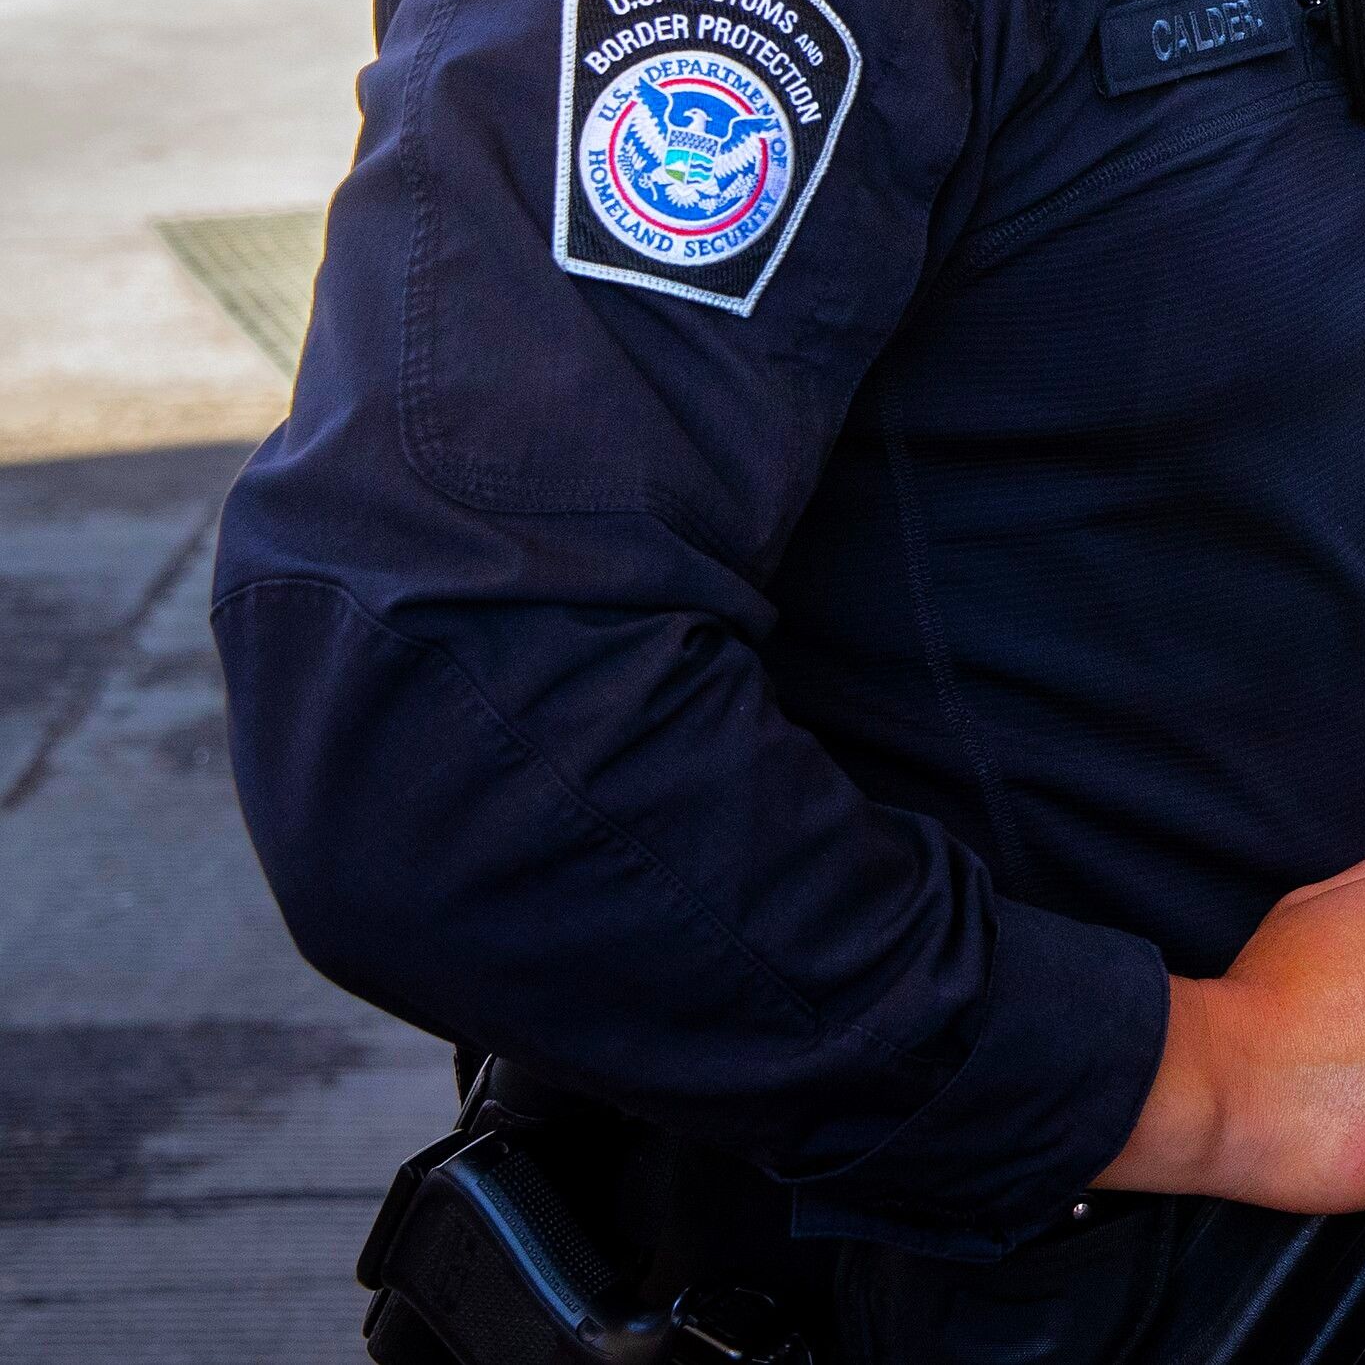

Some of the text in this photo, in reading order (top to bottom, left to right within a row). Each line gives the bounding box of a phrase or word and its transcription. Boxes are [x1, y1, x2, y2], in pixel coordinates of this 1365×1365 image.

[584, 13, 823, 125] BORDER PROTECTION
[794, 33, 825, 67] AND
[1152, 0, 1263, 62] CALDER
[598, 59, 788, 169] U.S. DEPARTMENT OF
[588, 149, 778, 258] HOMELAND SECURITY
